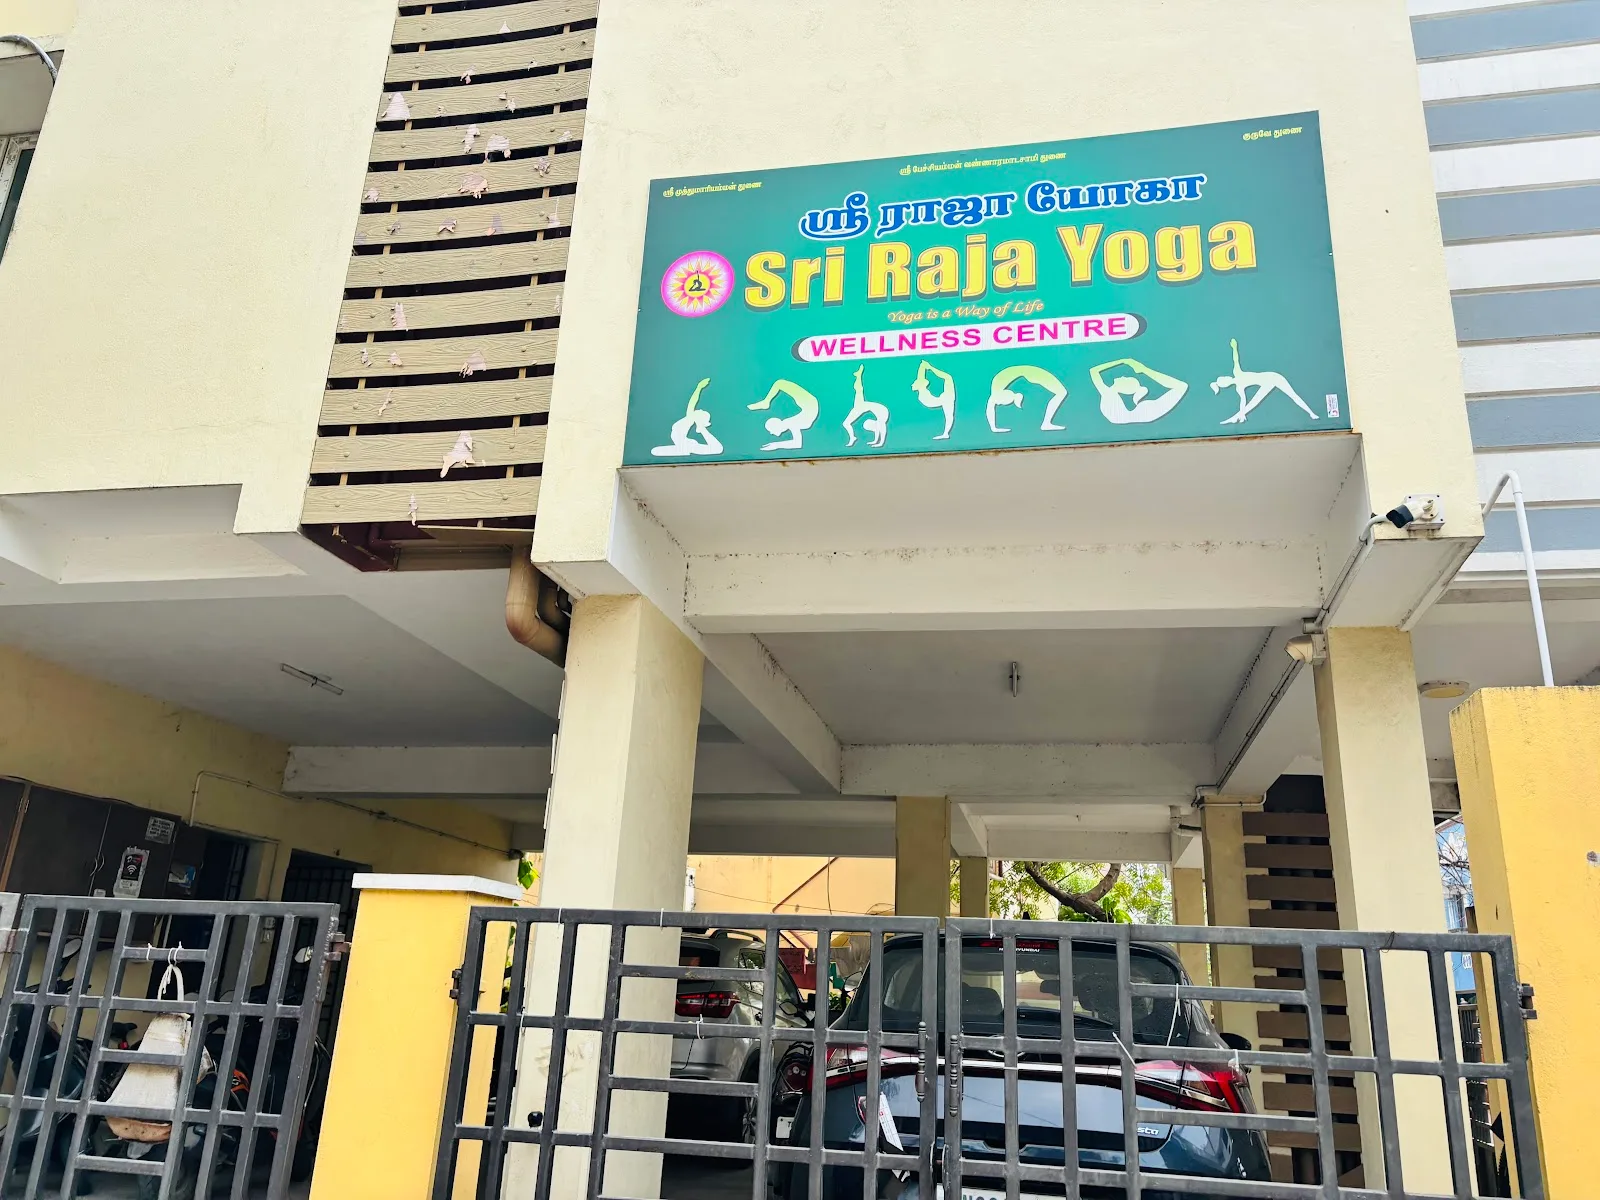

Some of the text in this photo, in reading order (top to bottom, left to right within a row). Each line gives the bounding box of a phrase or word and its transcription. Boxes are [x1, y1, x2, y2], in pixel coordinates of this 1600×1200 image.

[1273, 127, 1302, 138] துணை
[1040, 152, 1066, 163] துணை
[738, 182, 762, 191] துணை
[800, 173, 1207, 238] ஸ்ரீ ராஜா யோகா
[744, 220, 1257, 311] Sri Raja Yoga
[888, 300, 1044, 323] Yoga is a Way of Life
[810, 317, 1127, 357] WELLNESS CENTRE
[1137, 1127, 1160, 1136] sta
